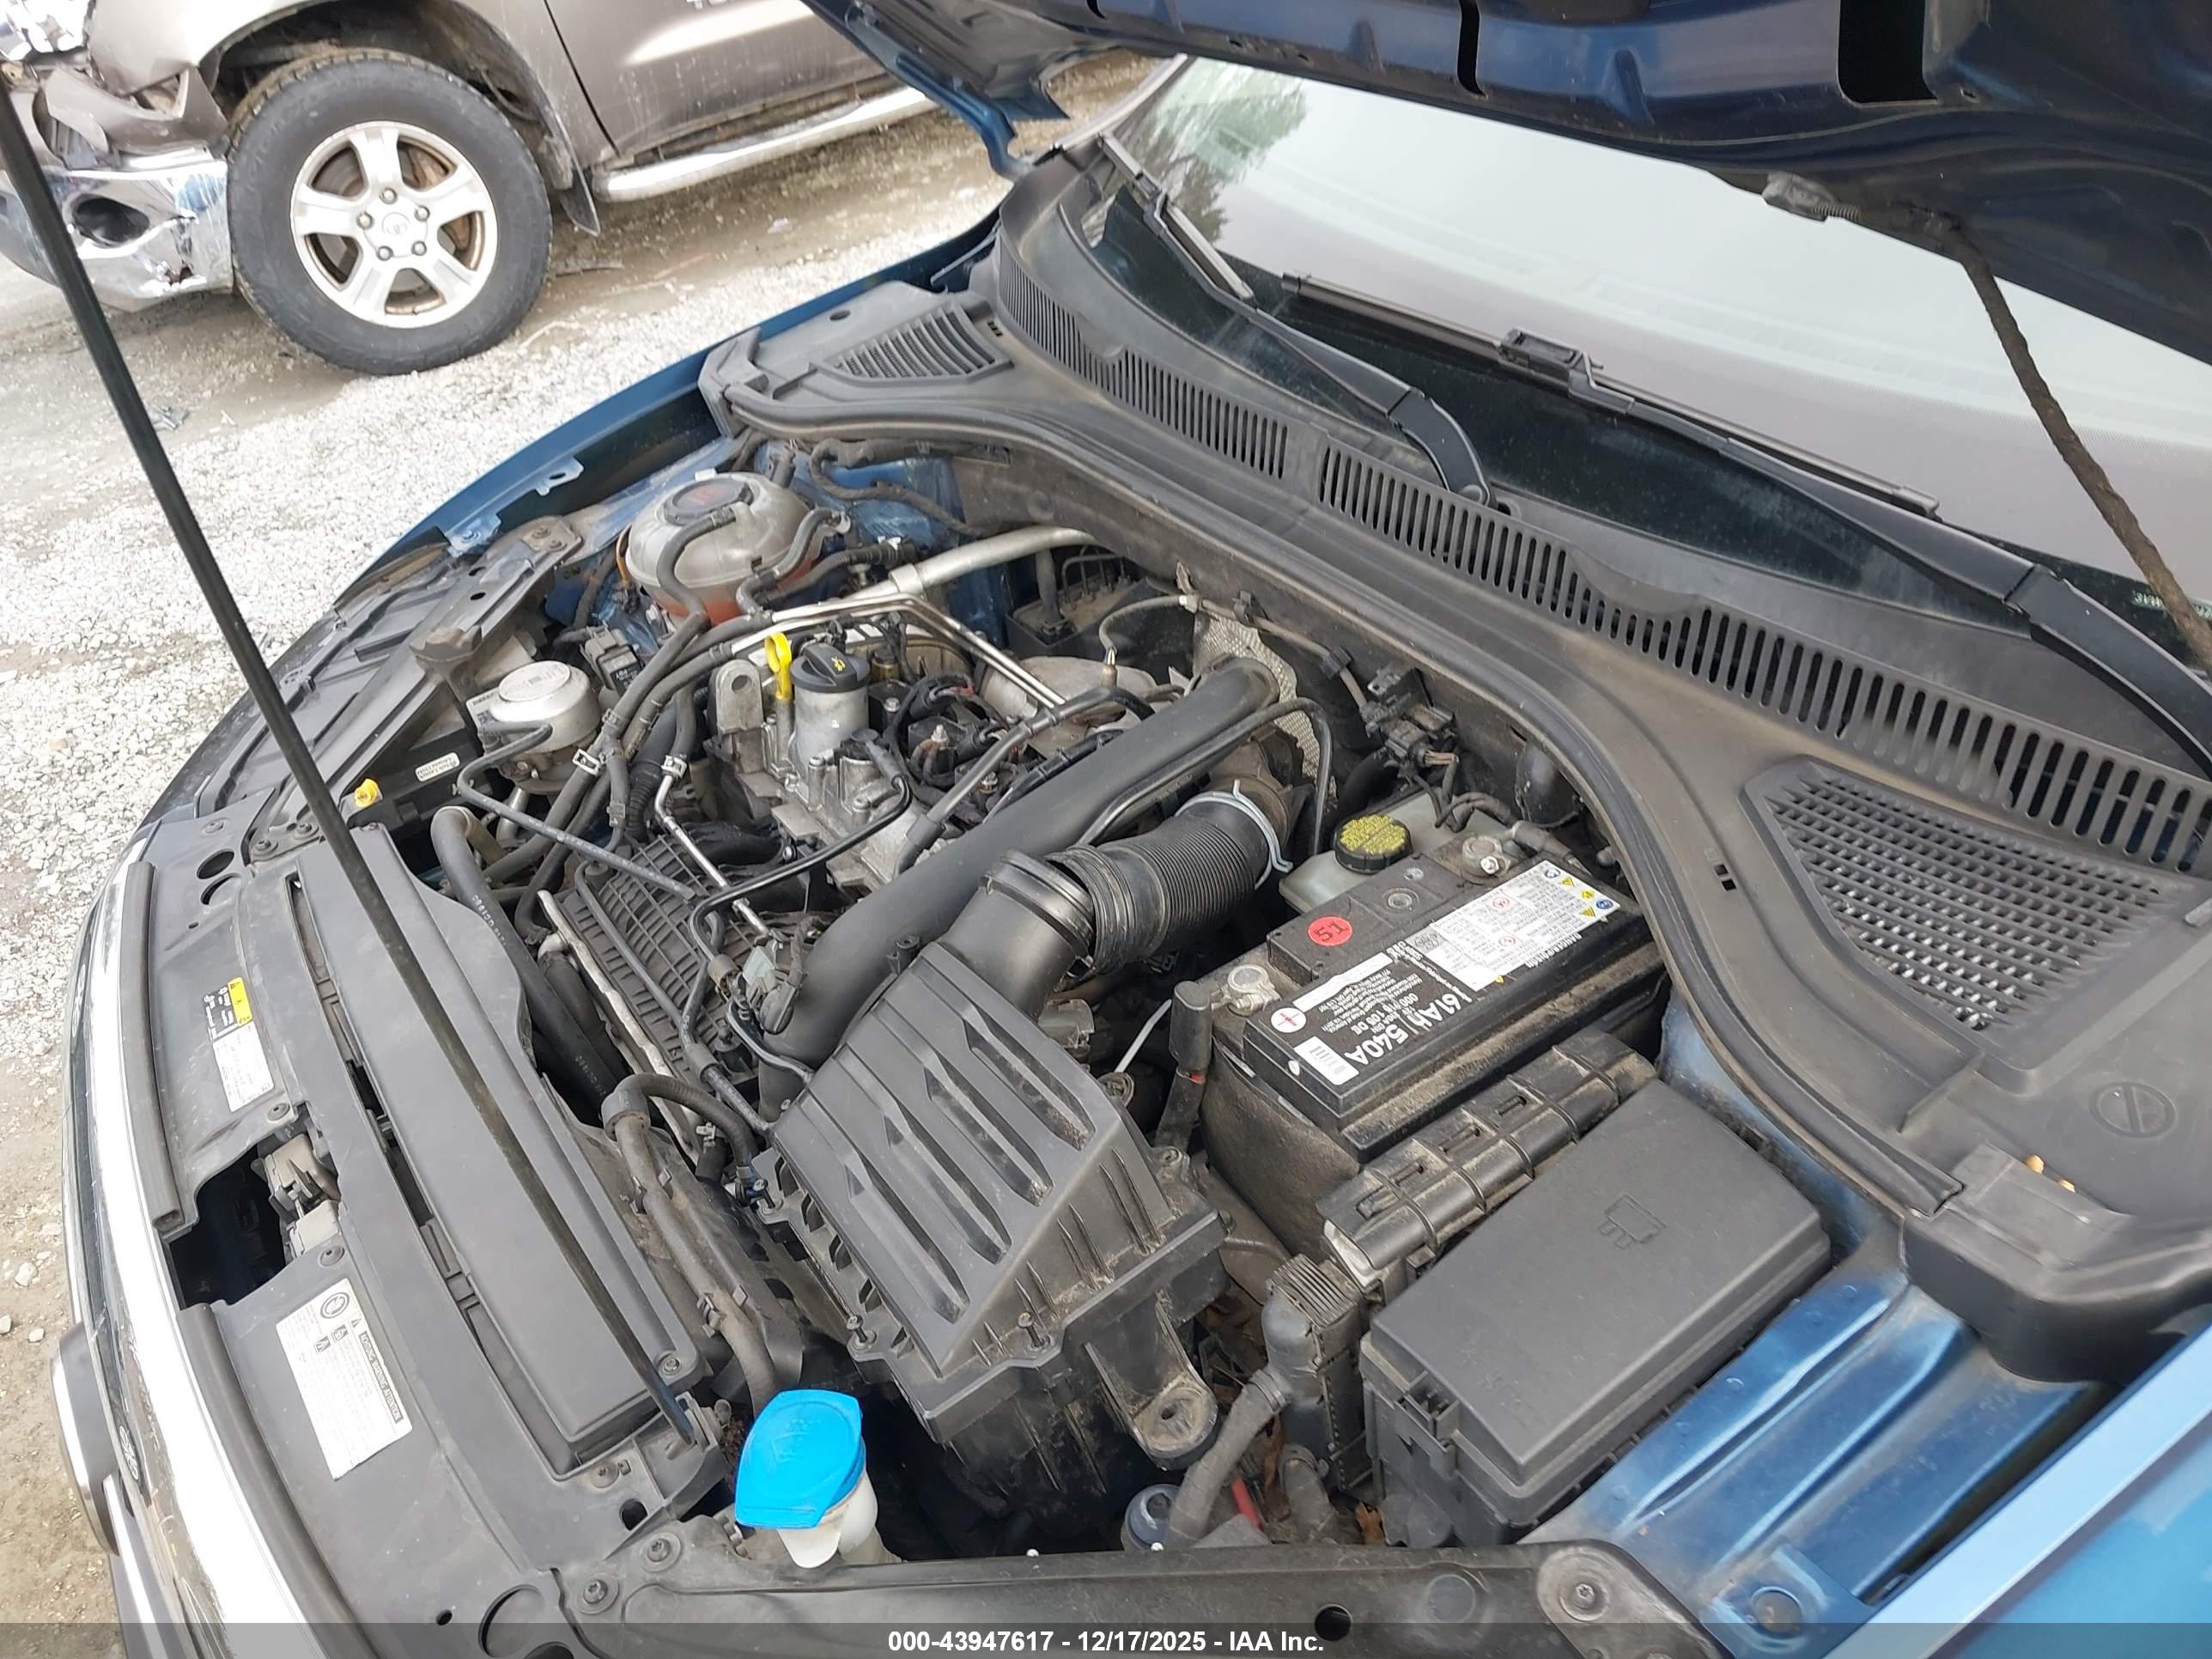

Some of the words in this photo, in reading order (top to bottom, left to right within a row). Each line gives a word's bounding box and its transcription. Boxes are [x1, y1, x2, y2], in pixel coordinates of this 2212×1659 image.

[1314, 921, 1347, 941] 51
[1407, 994, 1462, 1028] 61Ah
[1344, 1024, 1409, 1065] 540A
